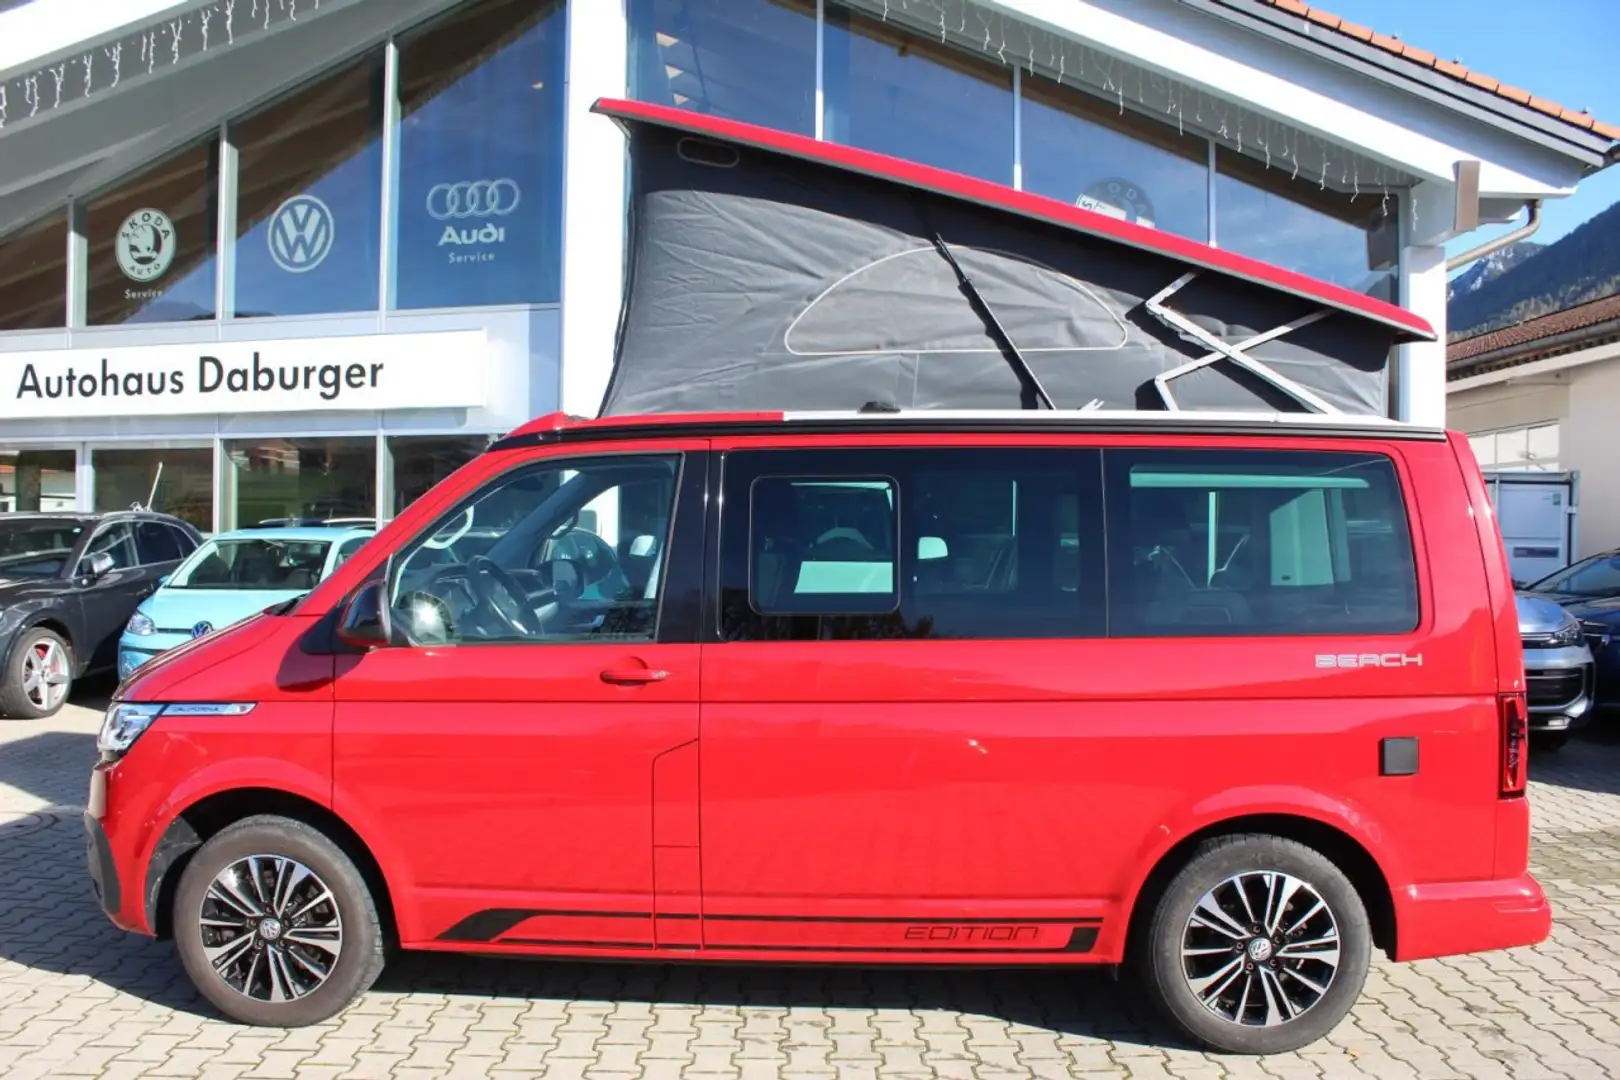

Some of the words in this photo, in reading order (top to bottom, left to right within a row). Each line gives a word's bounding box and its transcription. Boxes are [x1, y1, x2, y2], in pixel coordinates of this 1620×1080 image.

[438, 222, 505, 246] Audi
[448, 251, 495, 264] Service
[129, 263, 161, 275] AUTO
[124, 288, 163, 300] Service
[16, 358, 184, 399] Autohaus
[199, 352, 384, 400] Daburger
[1315, 653, 1423, 668] BEACH
[904, 926, 1039, 941] EDITION
